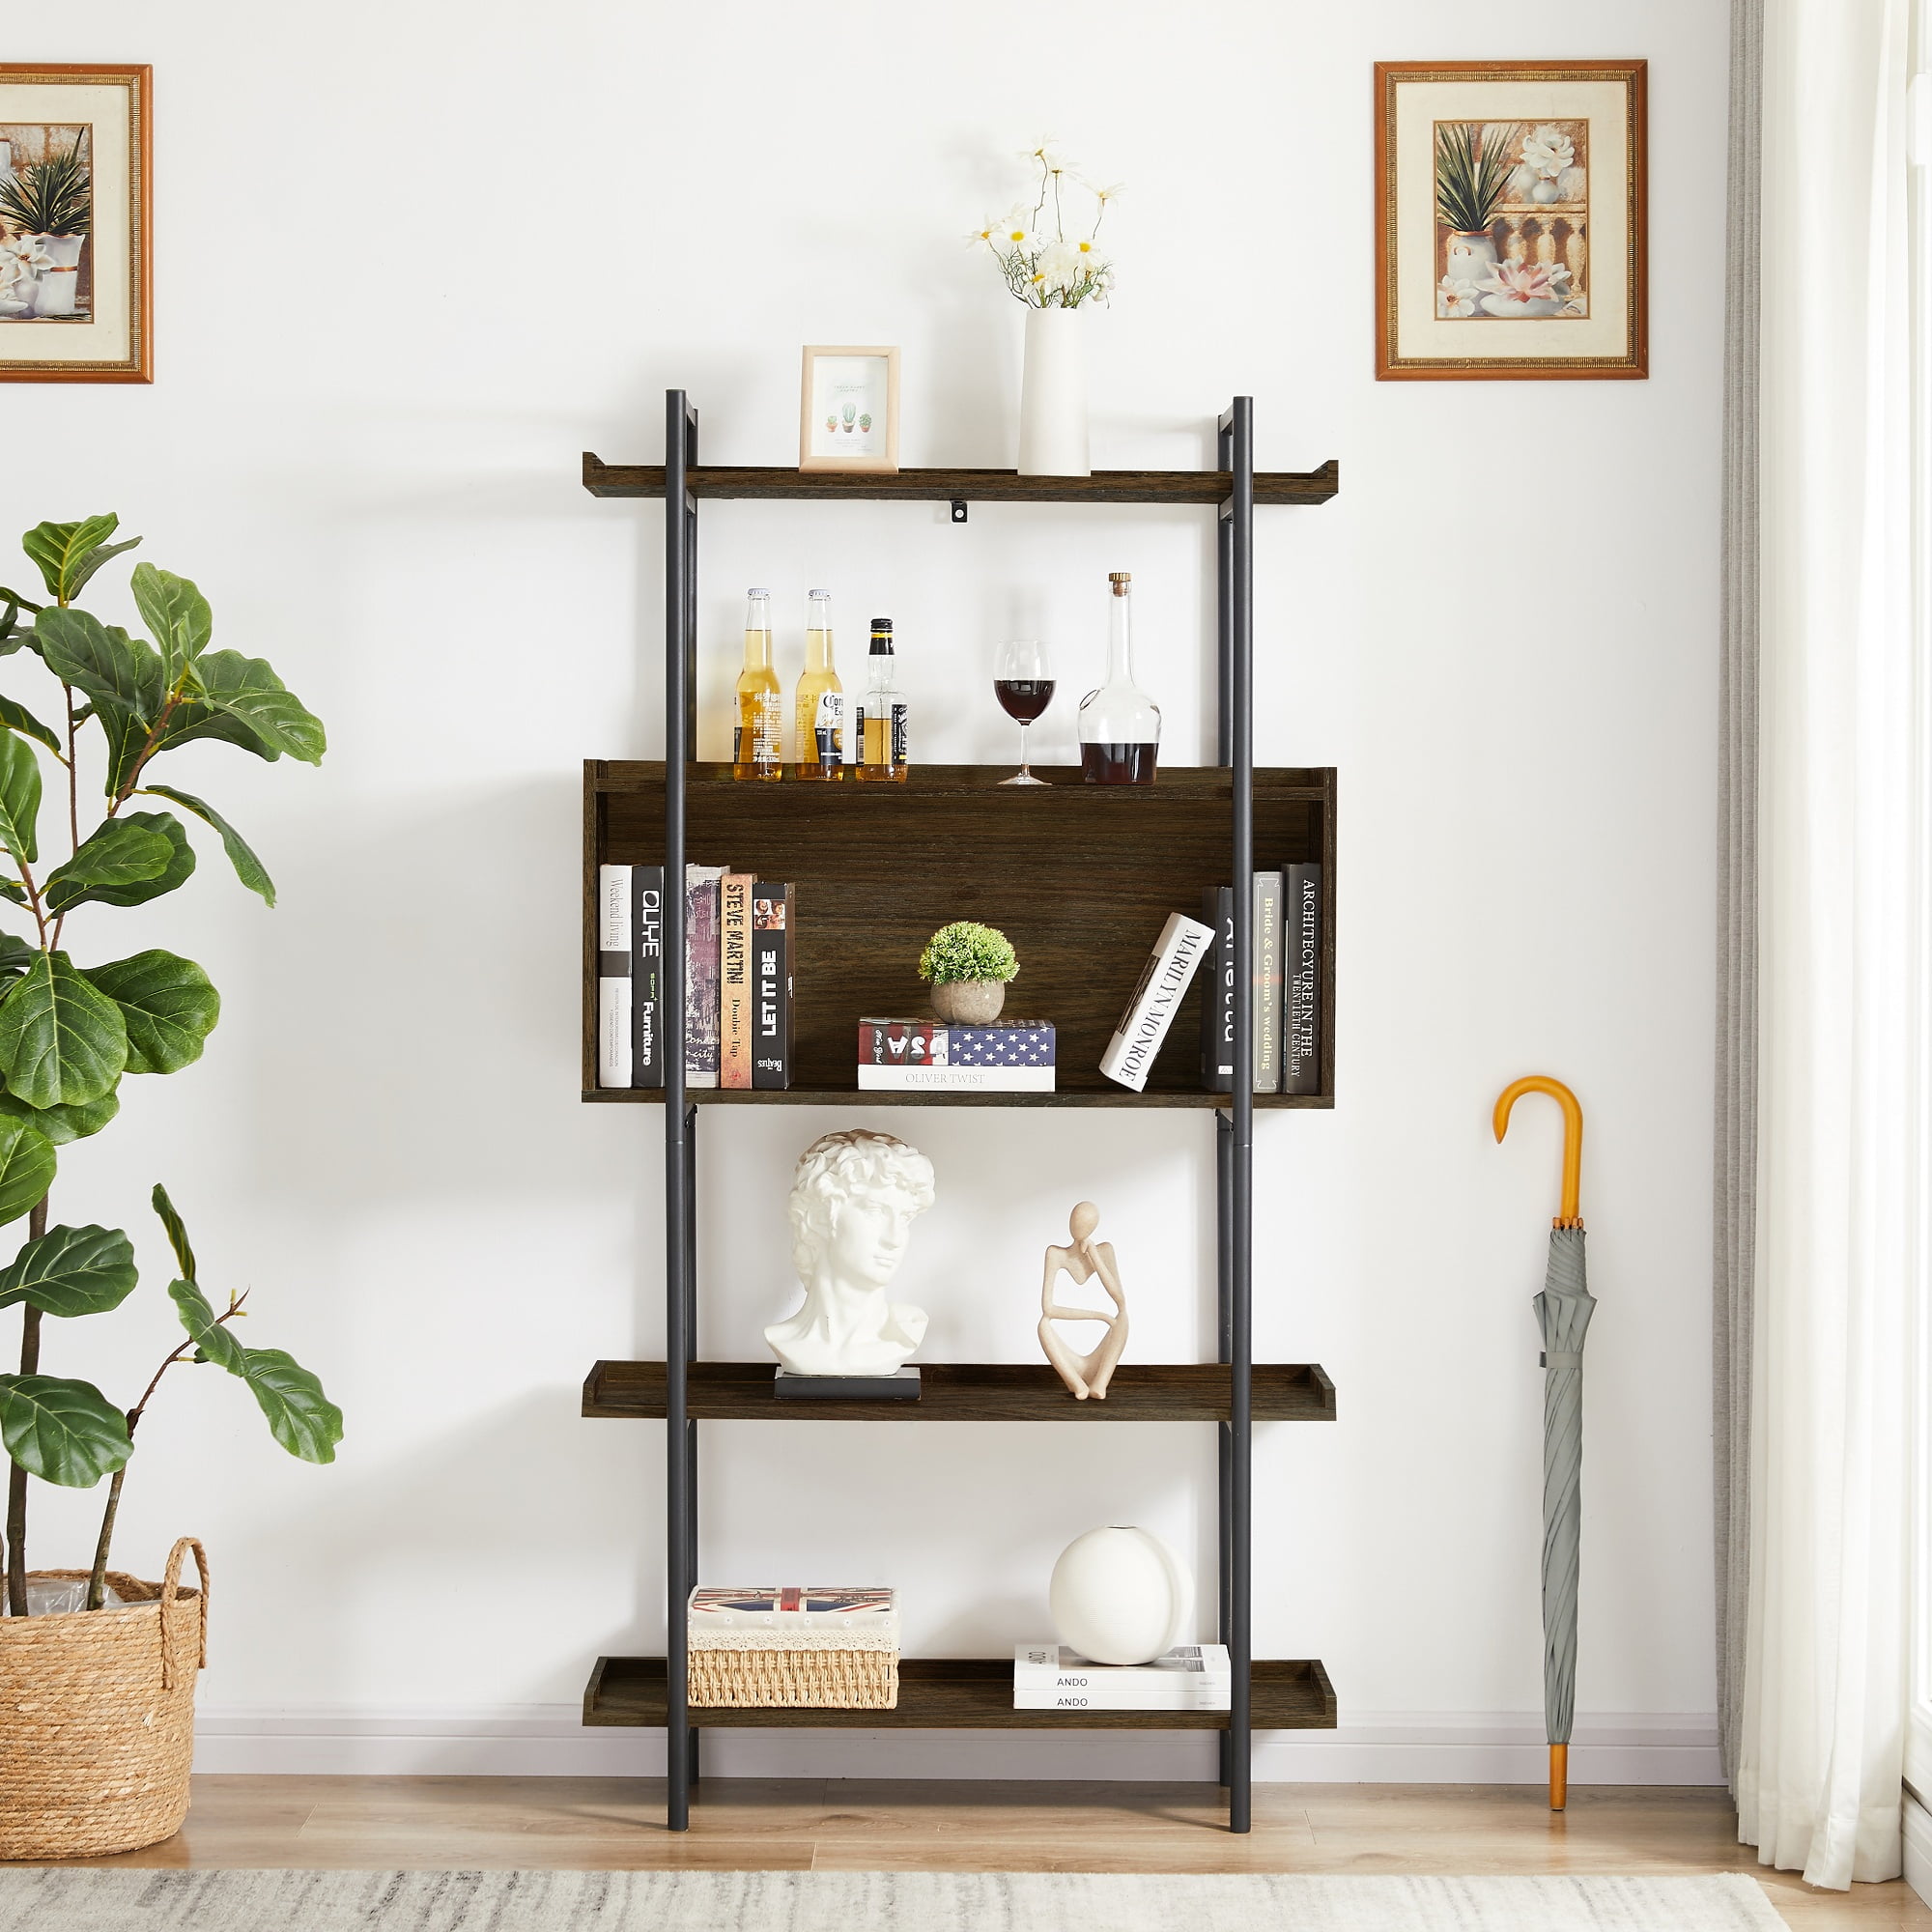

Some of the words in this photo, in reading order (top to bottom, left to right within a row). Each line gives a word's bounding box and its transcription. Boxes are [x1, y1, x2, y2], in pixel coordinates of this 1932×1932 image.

[610, 879, 623, 918] Weekend
[726, 884, 744, 926] STEVE
[1264, 897, 1274, 934] Bride
[606, 922, 623, 947] living
[641, 891, 660, 958] OUYE
[1264, 936, 1273, 950] &
[1301, 880, 1315, 1000] ARCHITECYURE
[726, 930, 744, 984] MARTINI
[761, 950, 777, 976] BE
[1154, 929, 1202, 1009] MARILYN
[761, 980, 777, 997] IT
[1263, 953, 1273, 1013] Groom's
[1292, 973, 1301, 1030] TWENTIETH
[761, 1001, 777, 1037] LET
[1301, 1004, 1313, 1020] IN
[729, 1038, 741, 1058] Tap
[1119, 1006, 1164, 1082] MONROE
[1261, 1016, 1273, 1070] wedding
[1291, 1034, 1301, 1077] CENTURY
[1300, 1025, 1313, 1057] THE
[905, 1073, 947, 1084] OLIVER
[950, 1073, 985, 1084] TWIST
[1057, 1678, 1088, 1687] ANDO
[1057, 1697, 1088, 1707] ANDO
